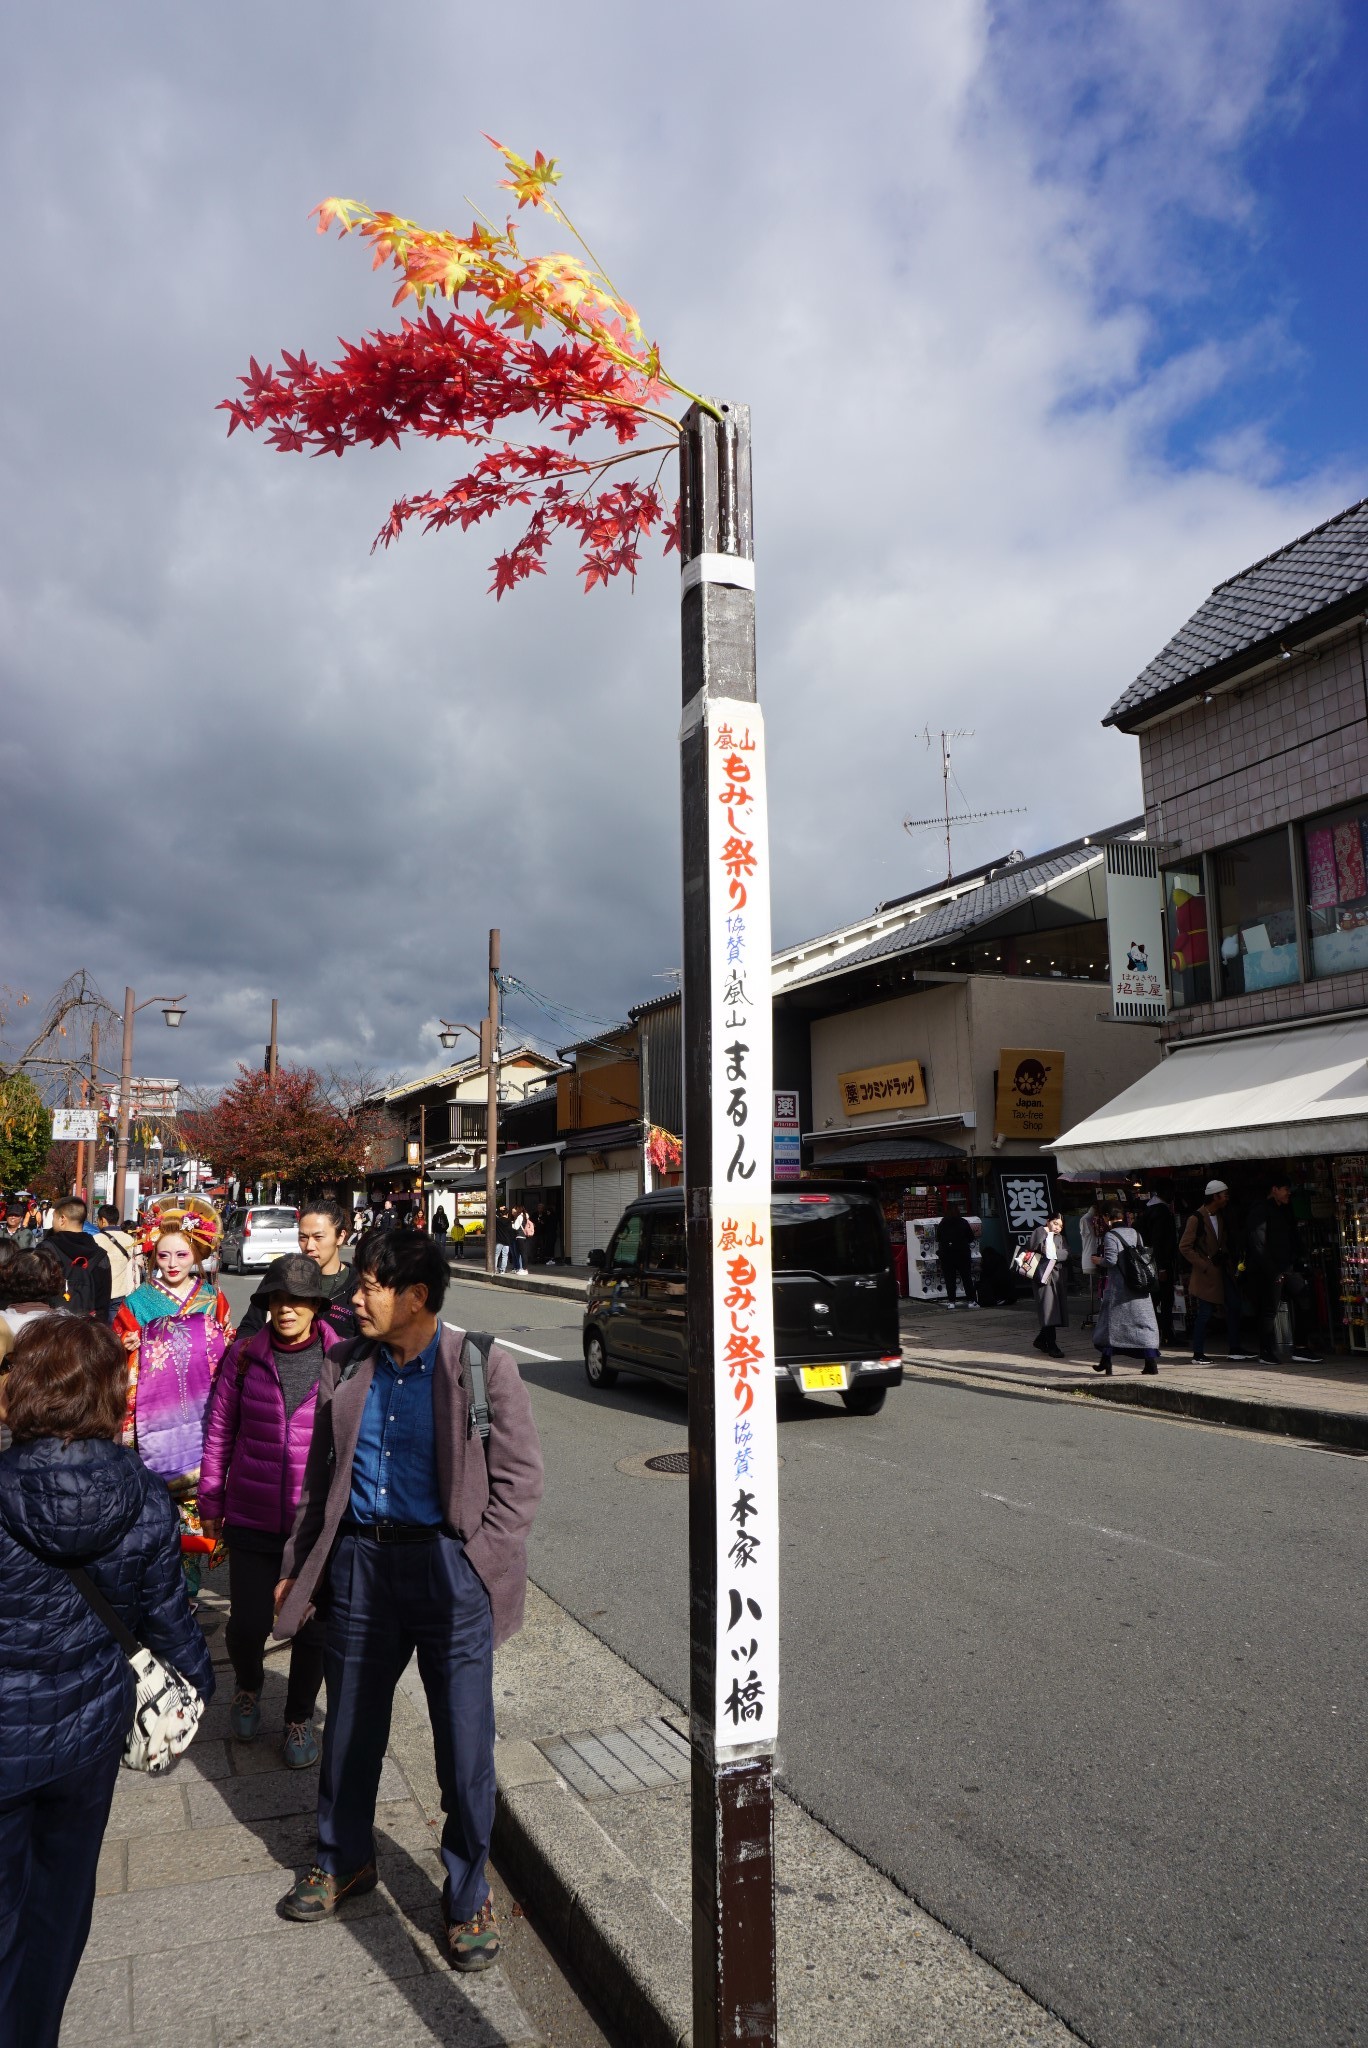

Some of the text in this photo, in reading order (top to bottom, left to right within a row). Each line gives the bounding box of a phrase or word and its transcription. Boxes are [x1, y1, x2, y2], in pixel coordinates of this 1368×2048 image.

[714, 723, 756, 751] 嵐山
[718, 752, 758, 912] もみじ祭り
[725, 915, 746, 965] 協賛
[1117, 982, 1163, 997] 招喜屋
[860, 1075, 915, 1101] コクミンドラッグ
[1016, 1098, 1044, 1109] Japan.
[723, 1039, 757, 1183] まるん
[777, 1096, 795, 1116] 薬
[1012, 1110, 1044, 1120] Tax-free
[1023, 1121, 1043, 1132] Shop
[1006, 1179, 1049, 1228] 薬
[717, 1216, 764, 1251] 嵐山
[722, 1253, 766, 1418] もみじ祭り
[734, 1421, 753, 1480] 協賛
